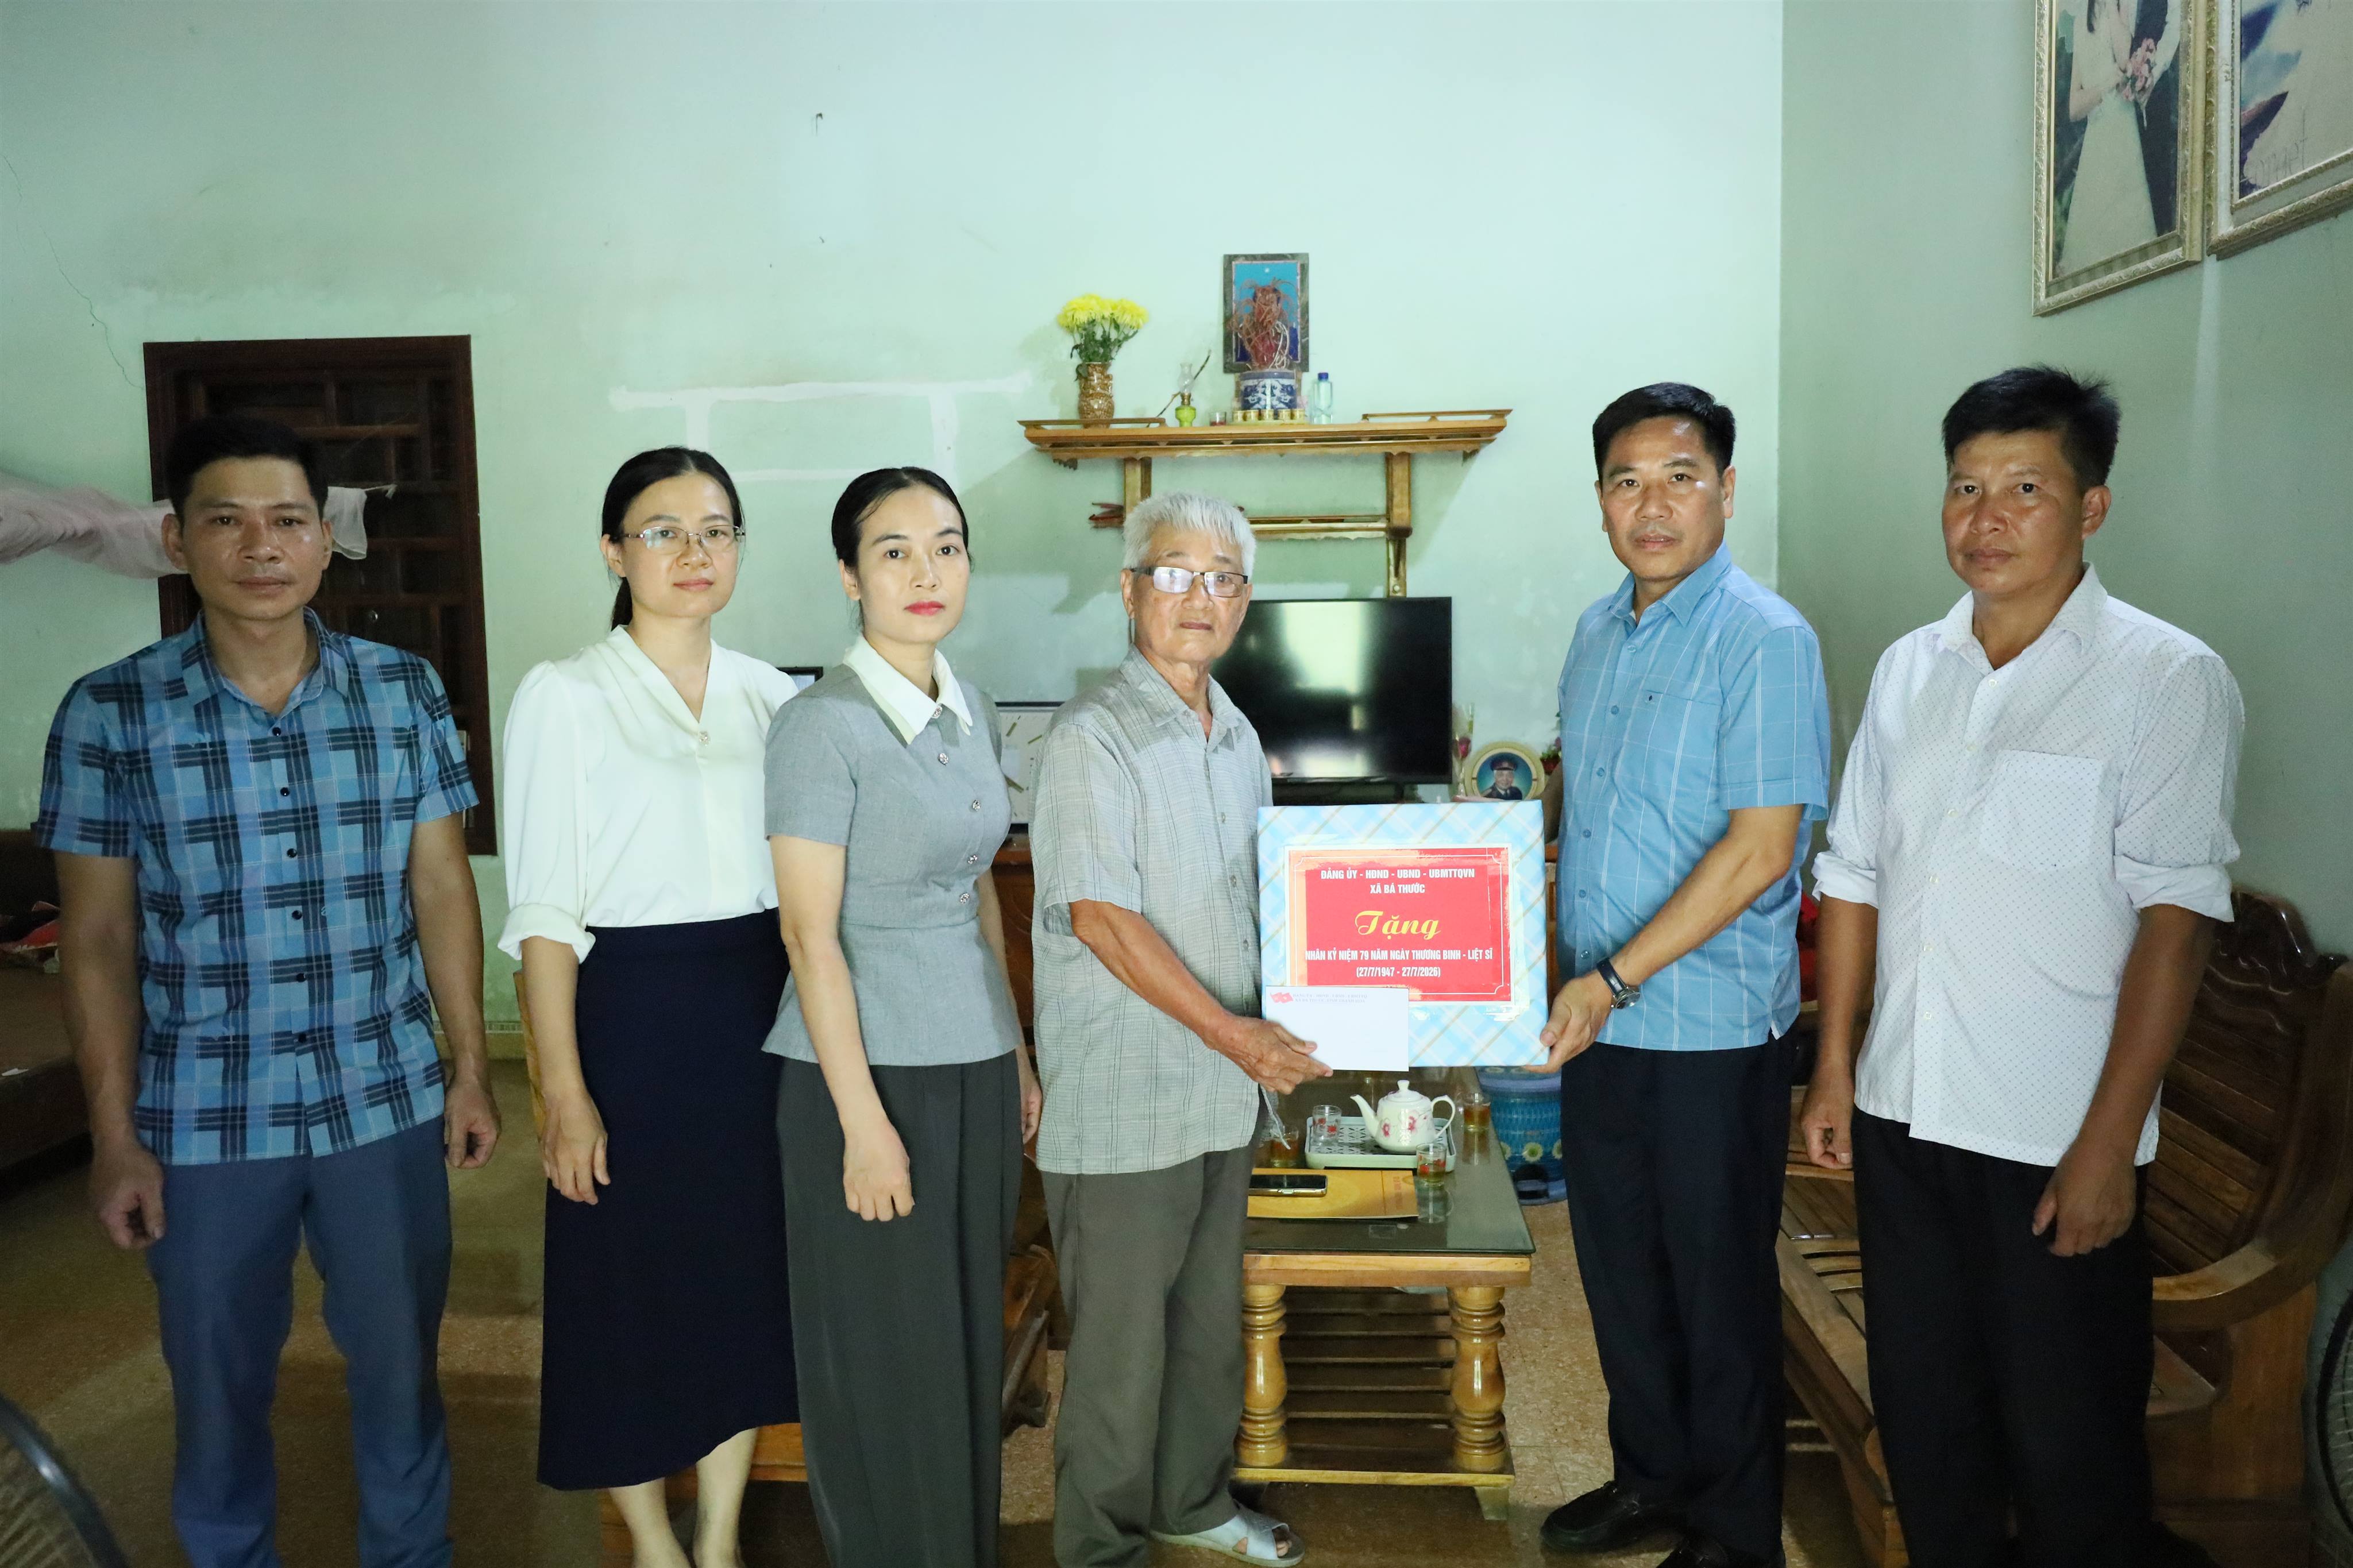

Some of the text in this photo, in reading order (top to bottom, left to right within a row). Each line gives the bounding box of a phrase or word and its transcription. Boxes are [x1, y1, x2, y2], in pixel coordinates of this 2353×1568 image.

[1321, 867, 1344, 879] ĐẢNG
[1347, 867, 1357, 879] ỦY
[1365, 870, 1388, 878] HĐND
[1397, 870, 1420, 878] UBND
[1429, 868, 1475, 878] UBMTTQVN
[1371, 883, 1425, 893] XÃ BÁ THƯỚC
[1355, 911, 1441, 940] Tặng
[1305, 949, 1325, 960] NHÂN
[1328, 948, 1336, 960] KỶ
[1339, 949, 1357, 962] NIỆM
[1360, 951, 1369, 960] 79
[1371, 949, 1388, 960] NĂM
[1390, 948, 1409, 960] NGÀY
[1411, 949, 1441, 960] THƯƠNG
[1443, 950, 1461, 959] BINH
[1468, 948, 1483, 961] LIỆT
[1485, 948, 1492, 959] SĨ
[1357, 967, 1395, 978] (27/7/1947
[1402, 967, 1440, 977] 27/7/2026)
